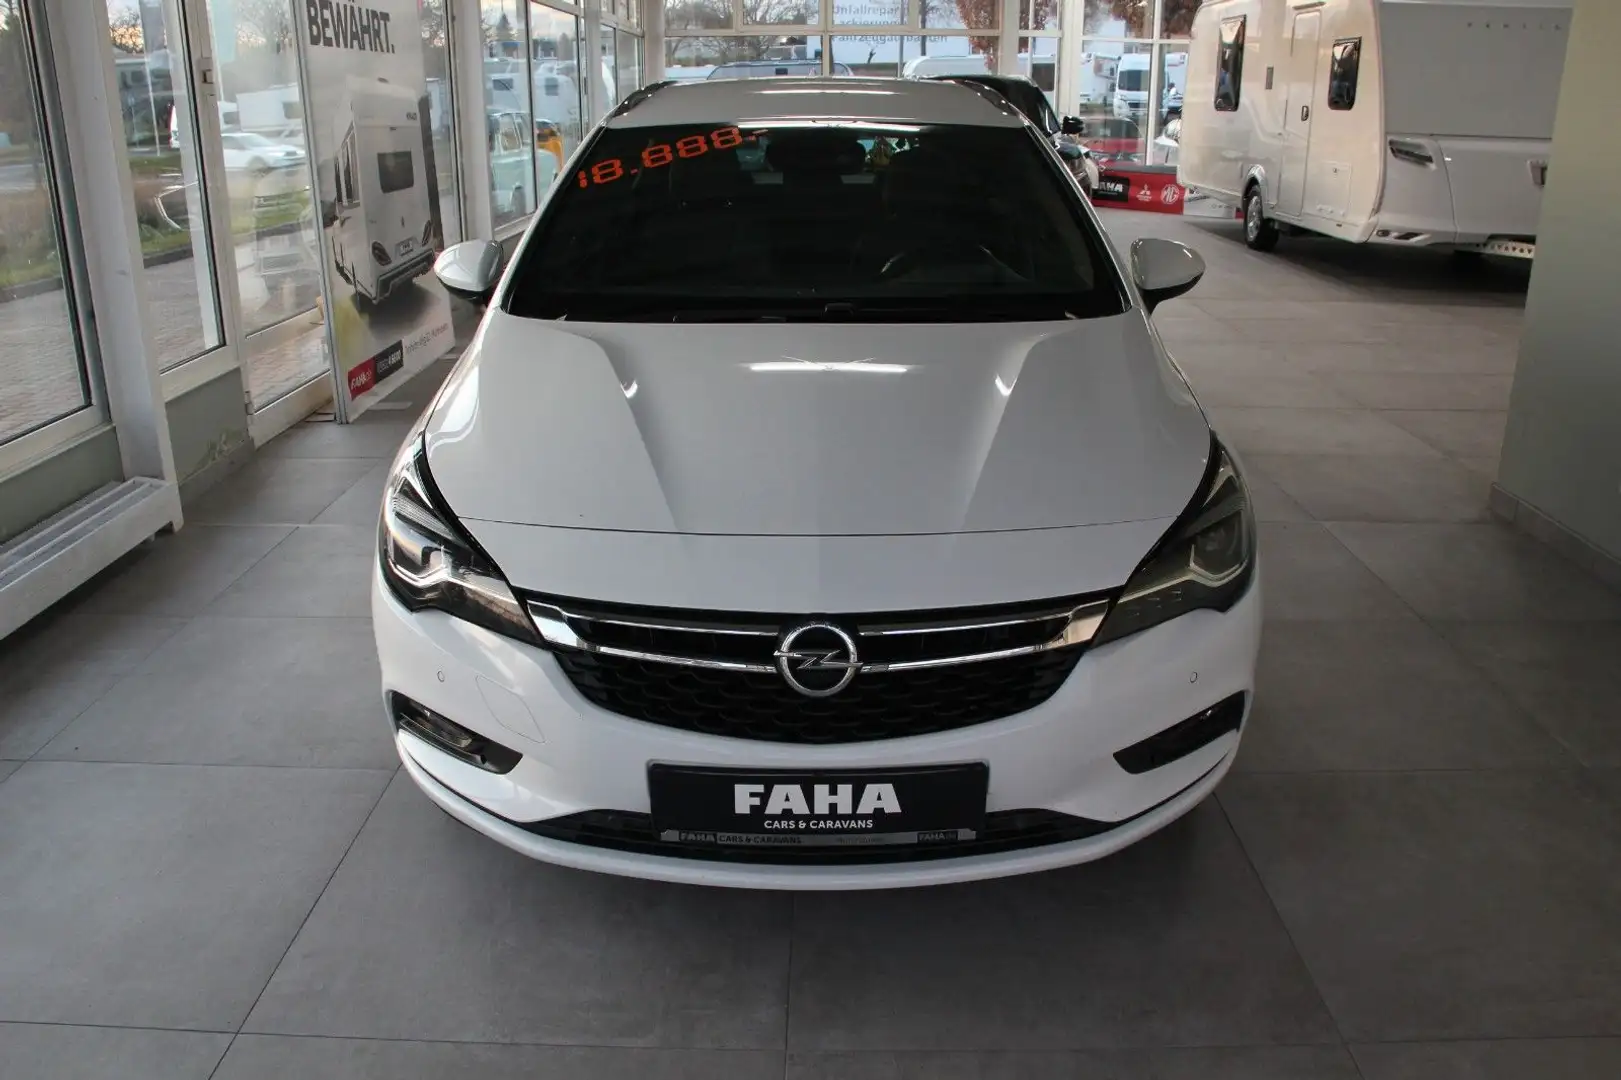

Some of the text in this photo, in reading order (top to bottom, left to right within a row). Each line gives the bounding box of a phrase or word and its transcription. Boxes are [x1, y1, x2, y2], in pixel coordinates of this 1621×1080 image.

[306, 0, 396, 54] BEWÄHRT.
[734, 783, 902, 814] FAHA
[764, 819, 873, 829] CARS & CARAVANS
